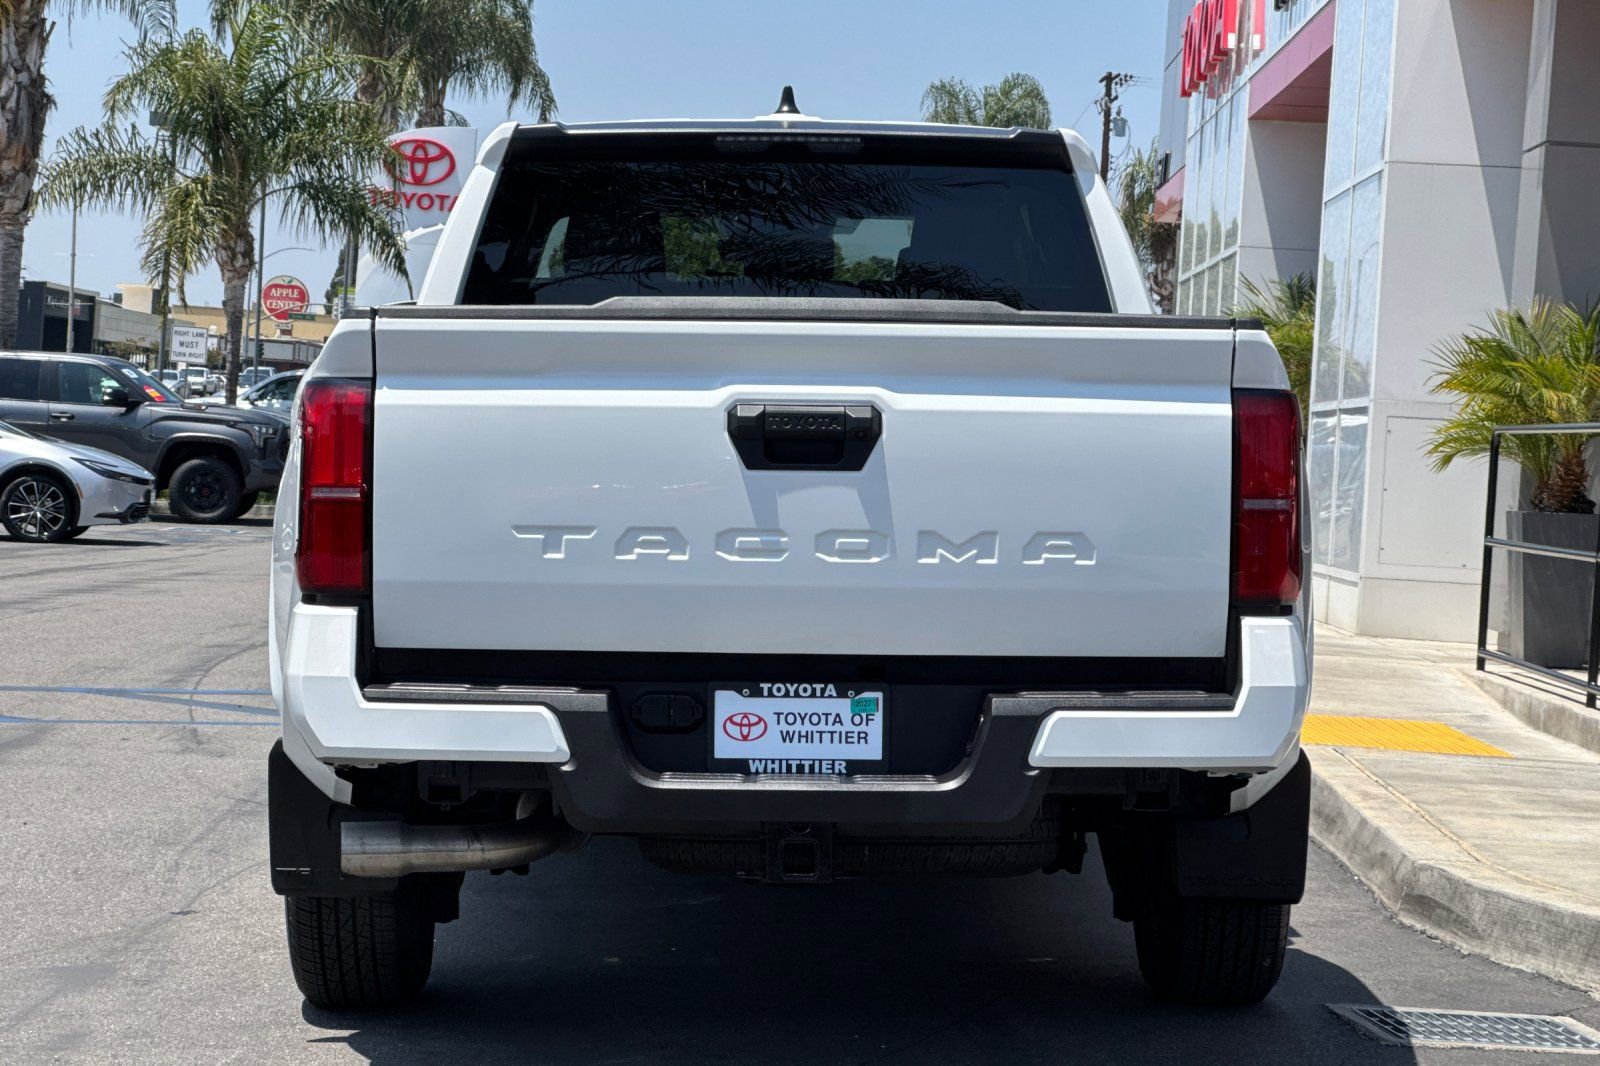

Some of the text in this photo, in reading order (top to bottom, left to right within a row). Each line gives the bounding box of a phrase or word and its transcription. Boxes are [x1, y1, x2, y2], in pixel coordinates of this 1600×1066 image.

[270, 288, 300, 298] APPLE
[266, 300, 301, 311] CENTER
[174, 330, 206, 339] RIGHT LANE
[179, 341, 199, 349] MUST
[173, 351, 205, 359] TURN RIGHT
[768, 416, 842, 430] TOYOTA
[511, 524, 1097, 565] TACOMA
[759, 682, 838, 698] TOYOTA
[772, 711, 876, 727] TOYOTA OF
[780, 730, 869, 745] WHITTIER
[749, 759, 847, 774] WHITTIER
